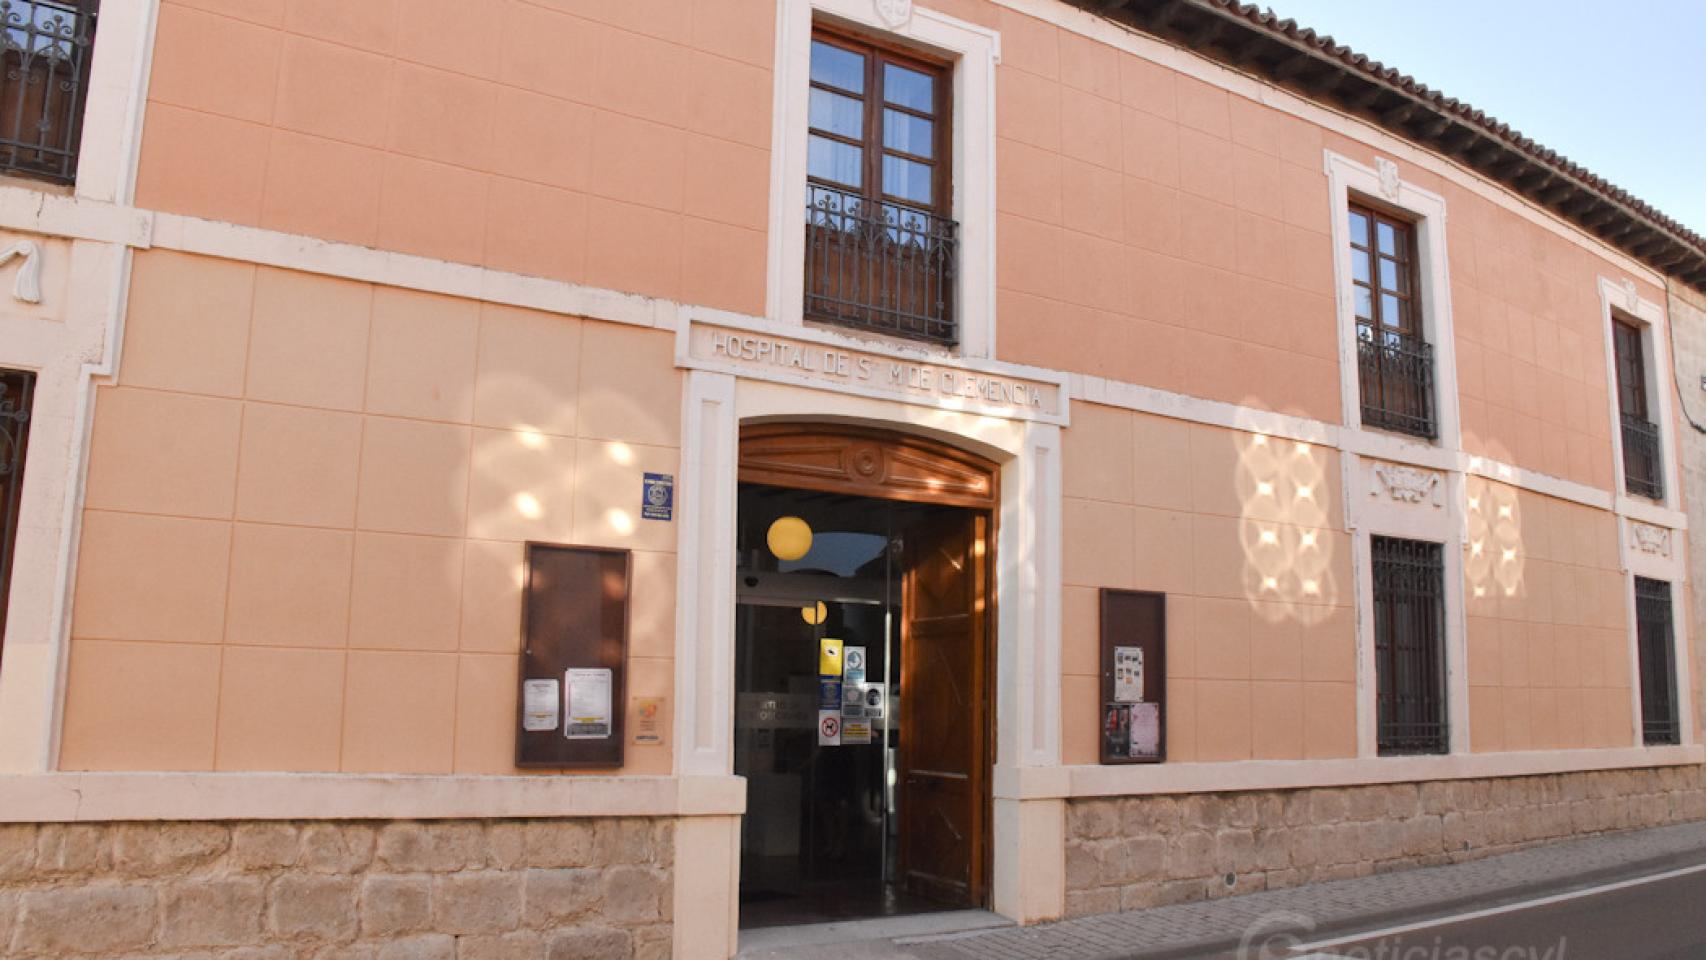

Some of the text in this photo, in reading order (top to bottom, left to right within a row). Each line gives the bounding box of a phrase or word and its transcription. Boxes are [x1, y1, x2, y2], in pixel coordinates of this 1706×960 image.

[712, 332, 816, 372] HOSPITAL
[824, 351, 850, 377] DE
[908, 366, 932, 391] DE
[942, 371, 1041, 408] CLEMENCIA
